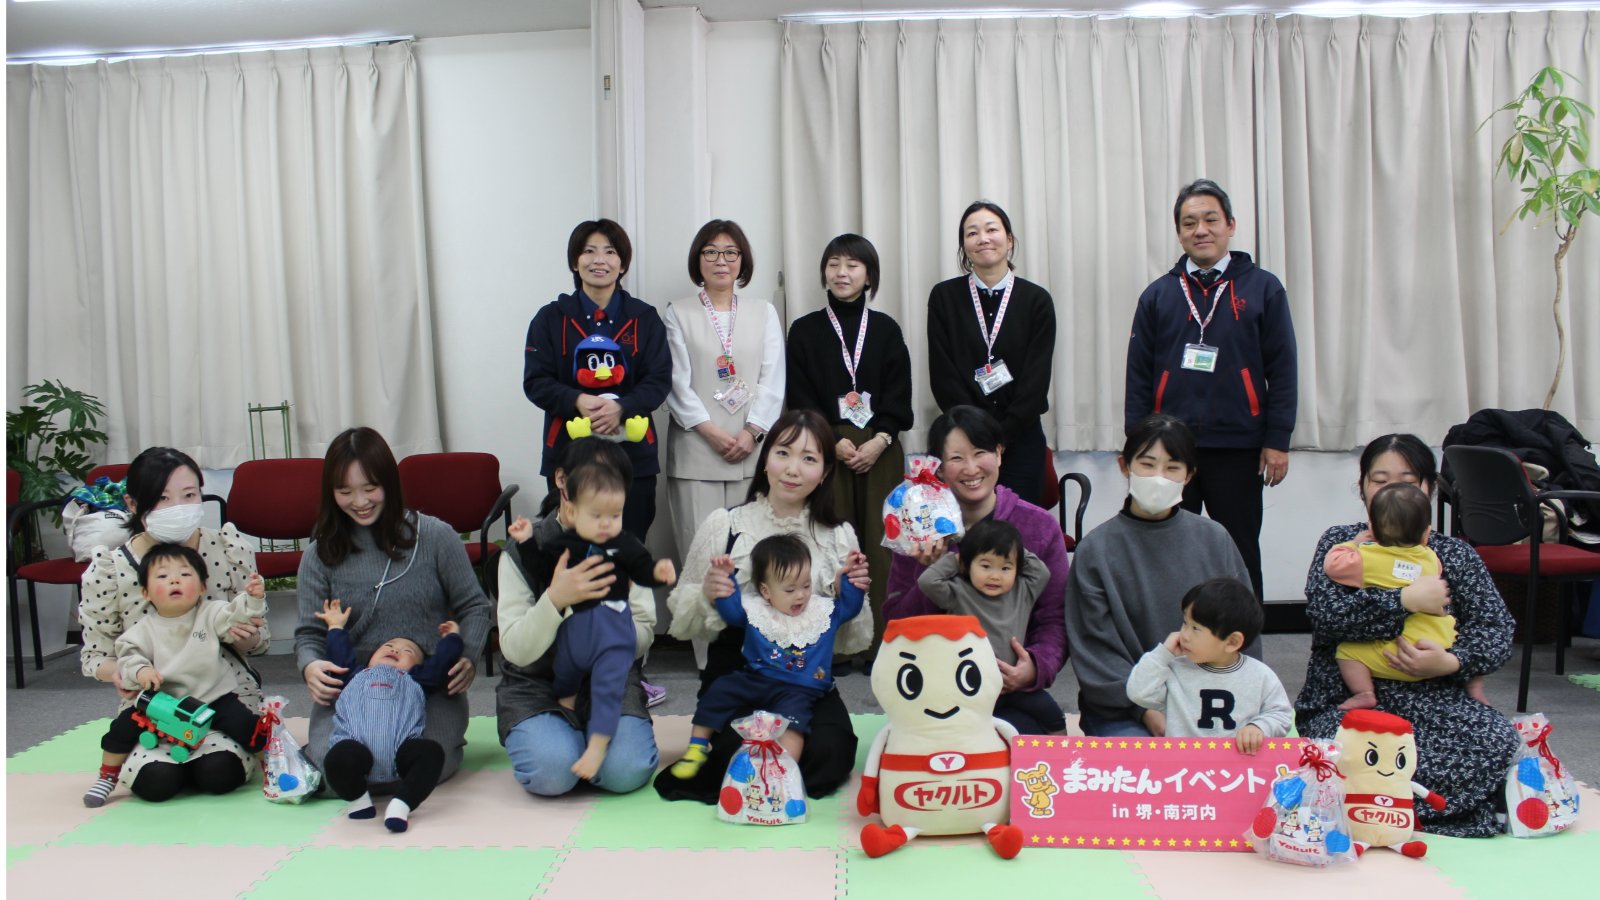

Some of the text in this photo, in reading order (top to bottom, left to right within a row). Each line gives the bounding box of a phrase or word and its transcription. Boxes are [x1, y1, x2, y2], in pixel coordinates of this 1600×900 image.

[1197, 689, 1237, 730] R
[939, 756, 955, 769] Y
[1063, 765, 1266, 794] まみたんイベント
[913, 783, 988, 807] ヤクルト
[1380, 797, 1389, 805] Y
[746, 814, 783, 825] Yakult
[1112, 803, 1217, 820] in 堺・南河内
[1360, 809, 1404, 826] ヤクルト
[1278, 840, 1320, 855] Yakult
